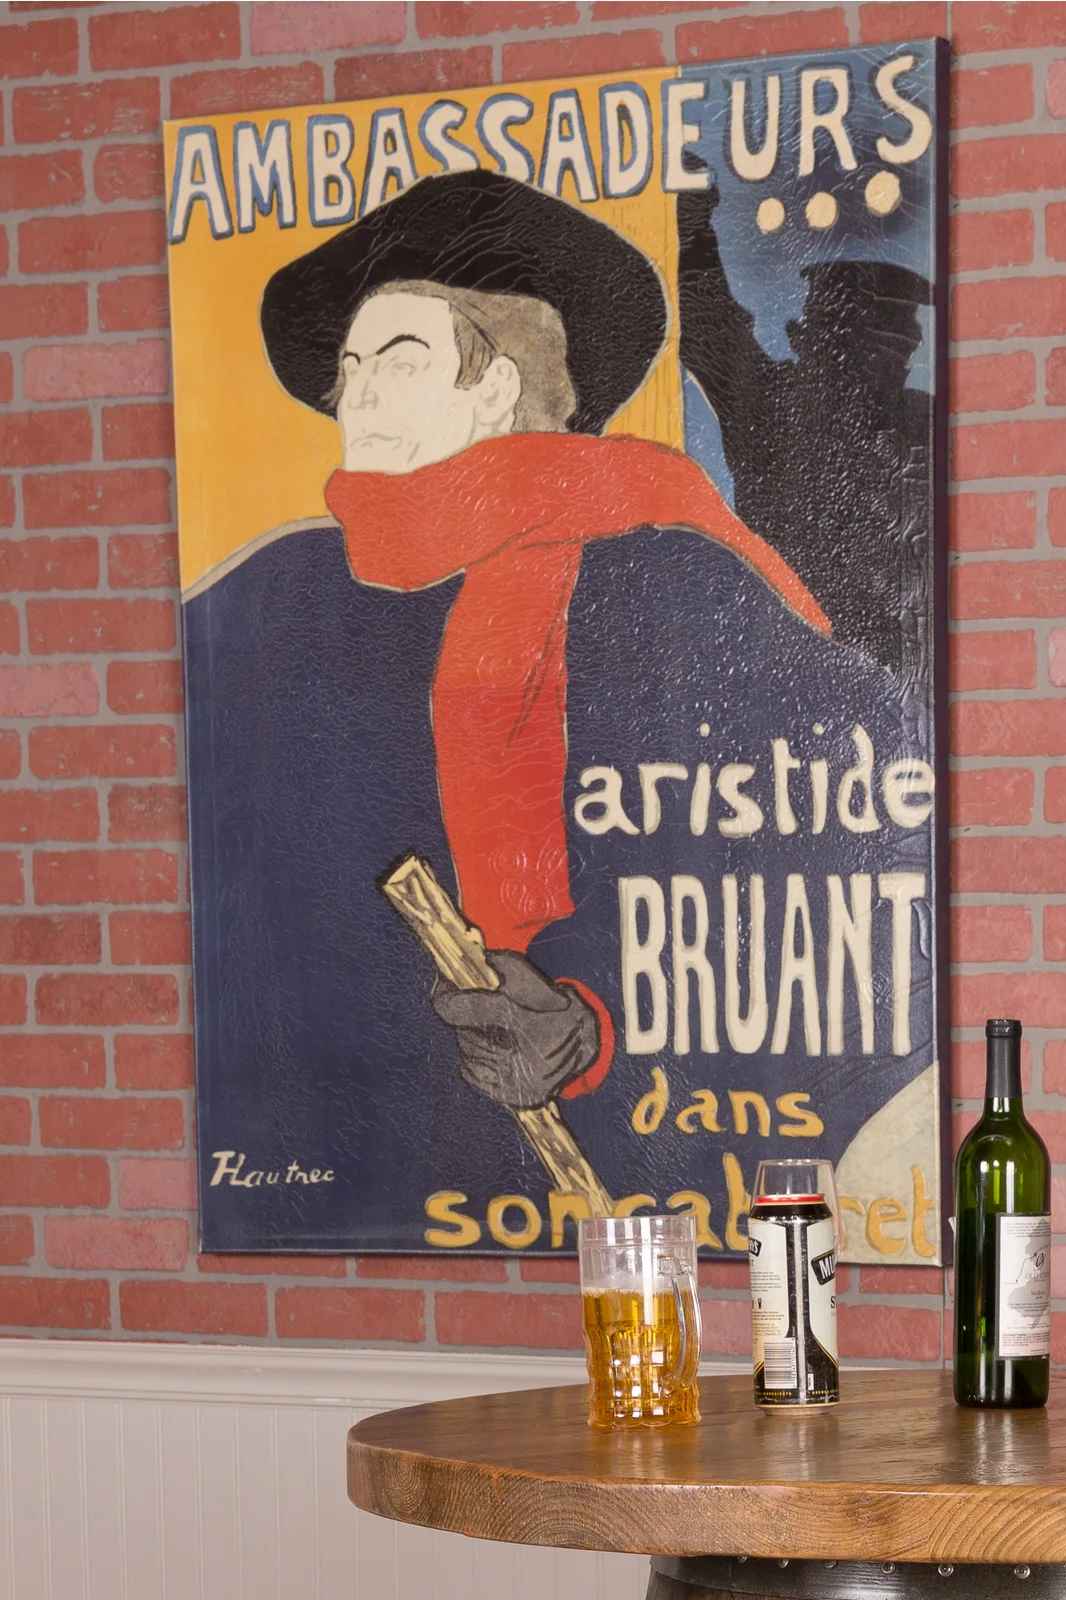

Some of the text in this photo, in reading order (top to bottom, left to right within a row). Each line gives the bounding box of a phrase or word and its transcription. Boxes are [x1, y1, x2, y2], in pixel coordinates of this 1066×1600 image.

[574, 723, 935, 838] aristide
[618, 873, 926, 1057] BRUANT
[632, 1066, 825, 1138] dans
[424, 1190, 592, 1249] son
